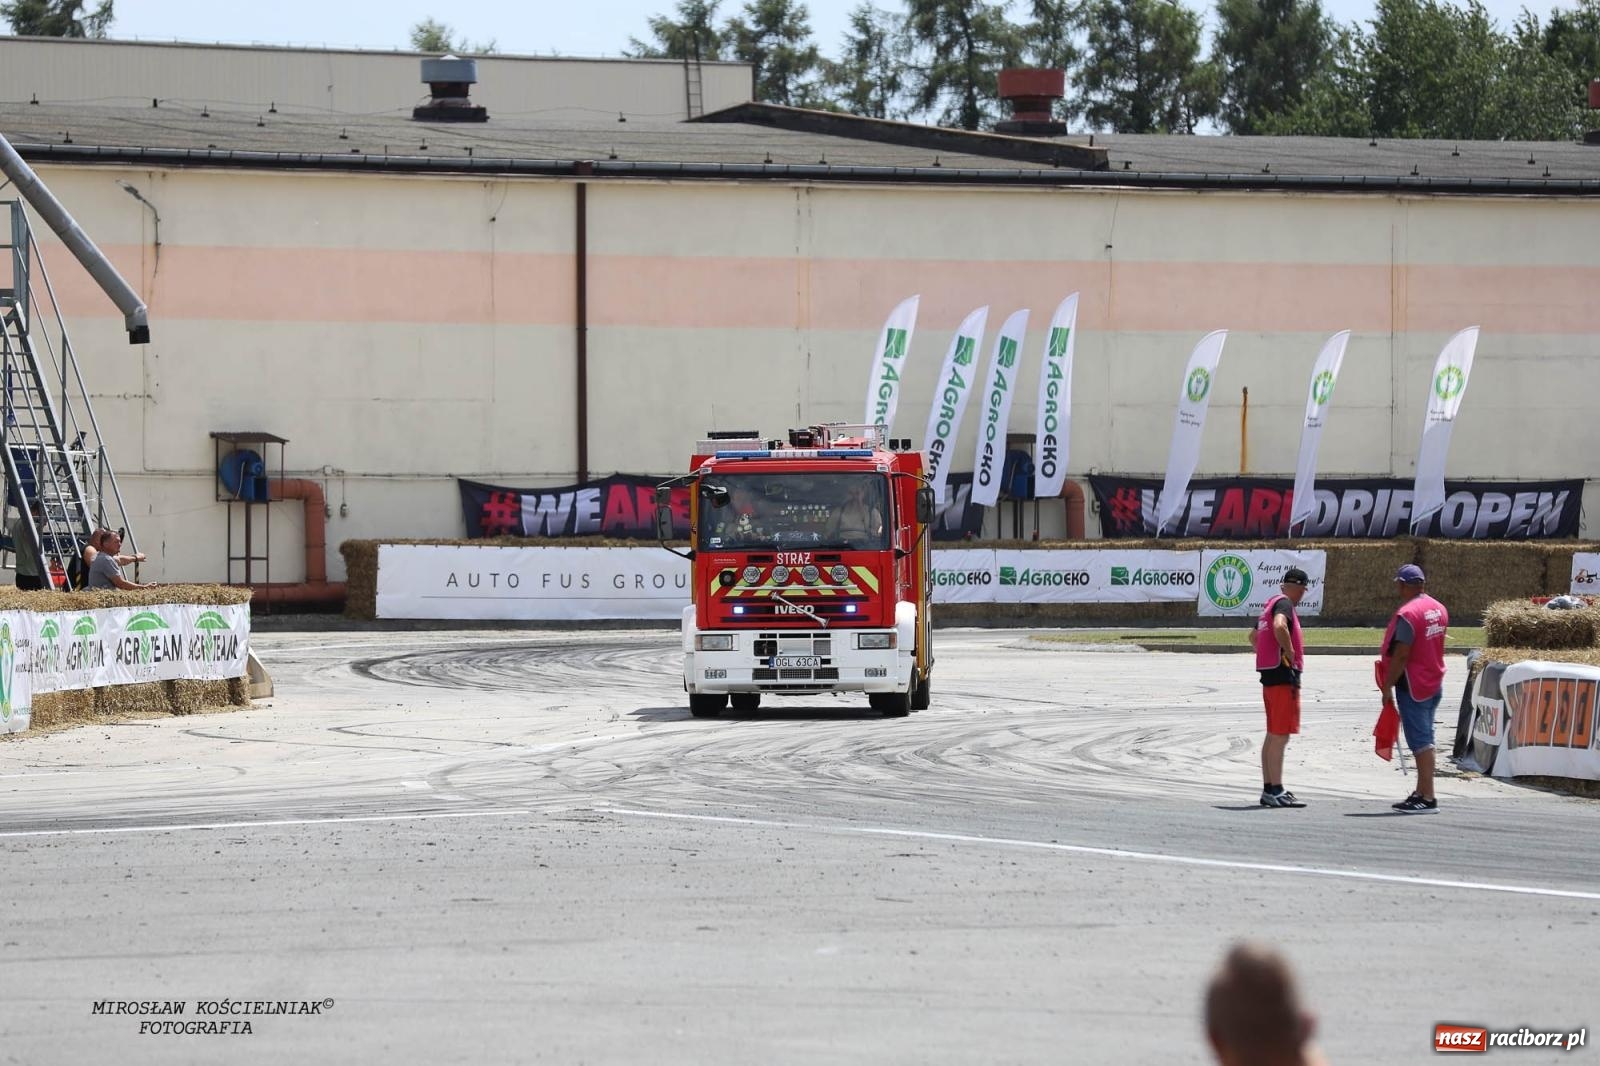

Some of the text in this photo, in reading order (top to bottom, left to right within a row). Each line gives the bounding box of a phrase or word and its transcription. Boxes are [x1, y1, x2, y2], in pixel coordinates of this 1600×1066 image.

[978, 369, 1008, 487] AGROEKO
[1041, 361, 1064, 478] AGROEKO
[446, 572, 687, 589] AUTO FUS GROU
[1018, 568, 1090, 586] AGROEKO
[1131, 568, 1195, 586] AGROEKO
[774, 605, 815, 614] IVECO
[775, 657, 819, 667] OGL 63CA
